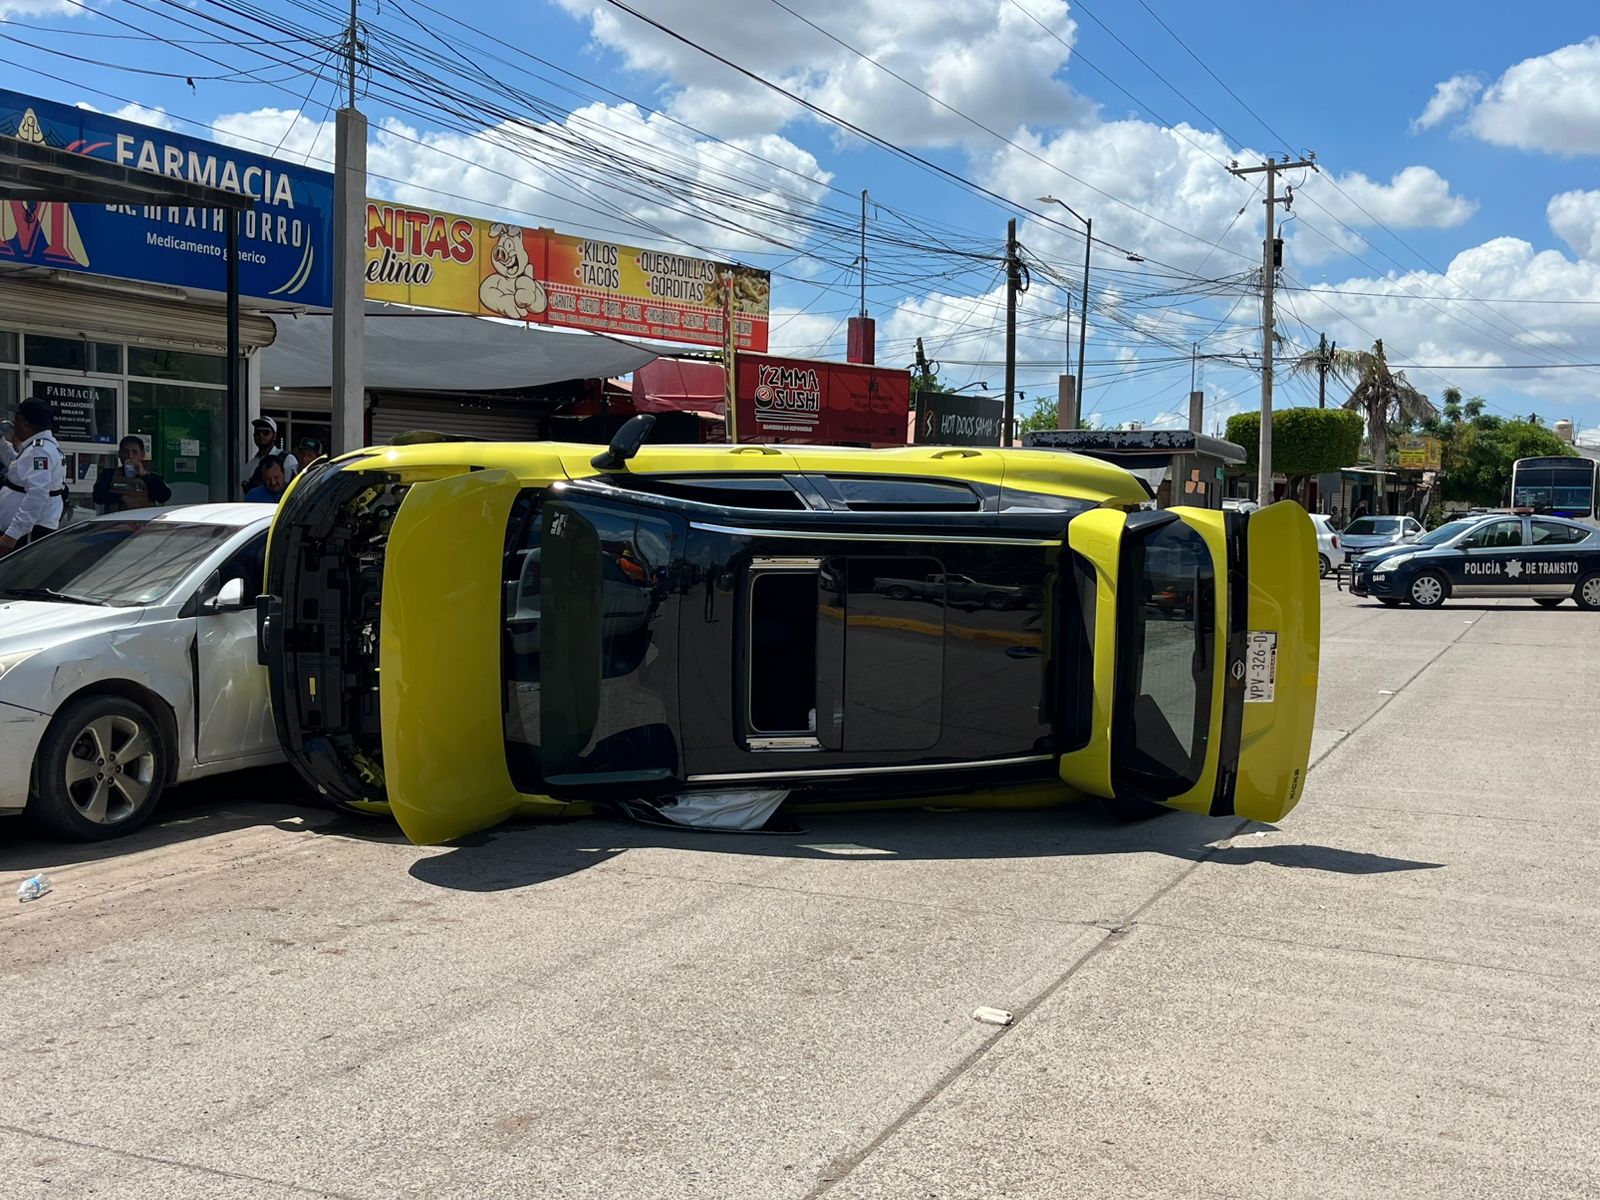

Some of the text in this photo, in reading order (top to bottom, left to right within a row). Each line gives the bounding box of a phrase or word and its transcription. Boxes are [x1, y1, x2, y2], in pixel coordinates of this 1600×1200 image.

[116, 133, 295, 209] FARMACIA
[144, 206, 302, 248] MAXIAORRO
[365, 203, 475, 264] NITAS
[146, 232, 266, 264] Medicamento gnerico
[583, 240, 618, 266] KILOS
[581, 263, 619, 289] TACOS
[640, 251, 716, 283] QUESADILLAS
[651, 276, 705, 302] GORDITAS
[758, 364, 819, 391] YZMMA
[46, 386, 100, 400] FARMACIA
[774, 388, 820, 411] SUSHI
[941, 414, 956, 435] HOT
[956, 415, 975, 437] DOGS
[1372, 574, 1386, 583] 0440
[1464, 559, 1501, 575] POLICÍA
[1526, 561, 1579, 574] DE TRANSITO
[1250, 635, 1268, 700] VPV-326-D
[1289, 768, 1300, 800] KICKS
